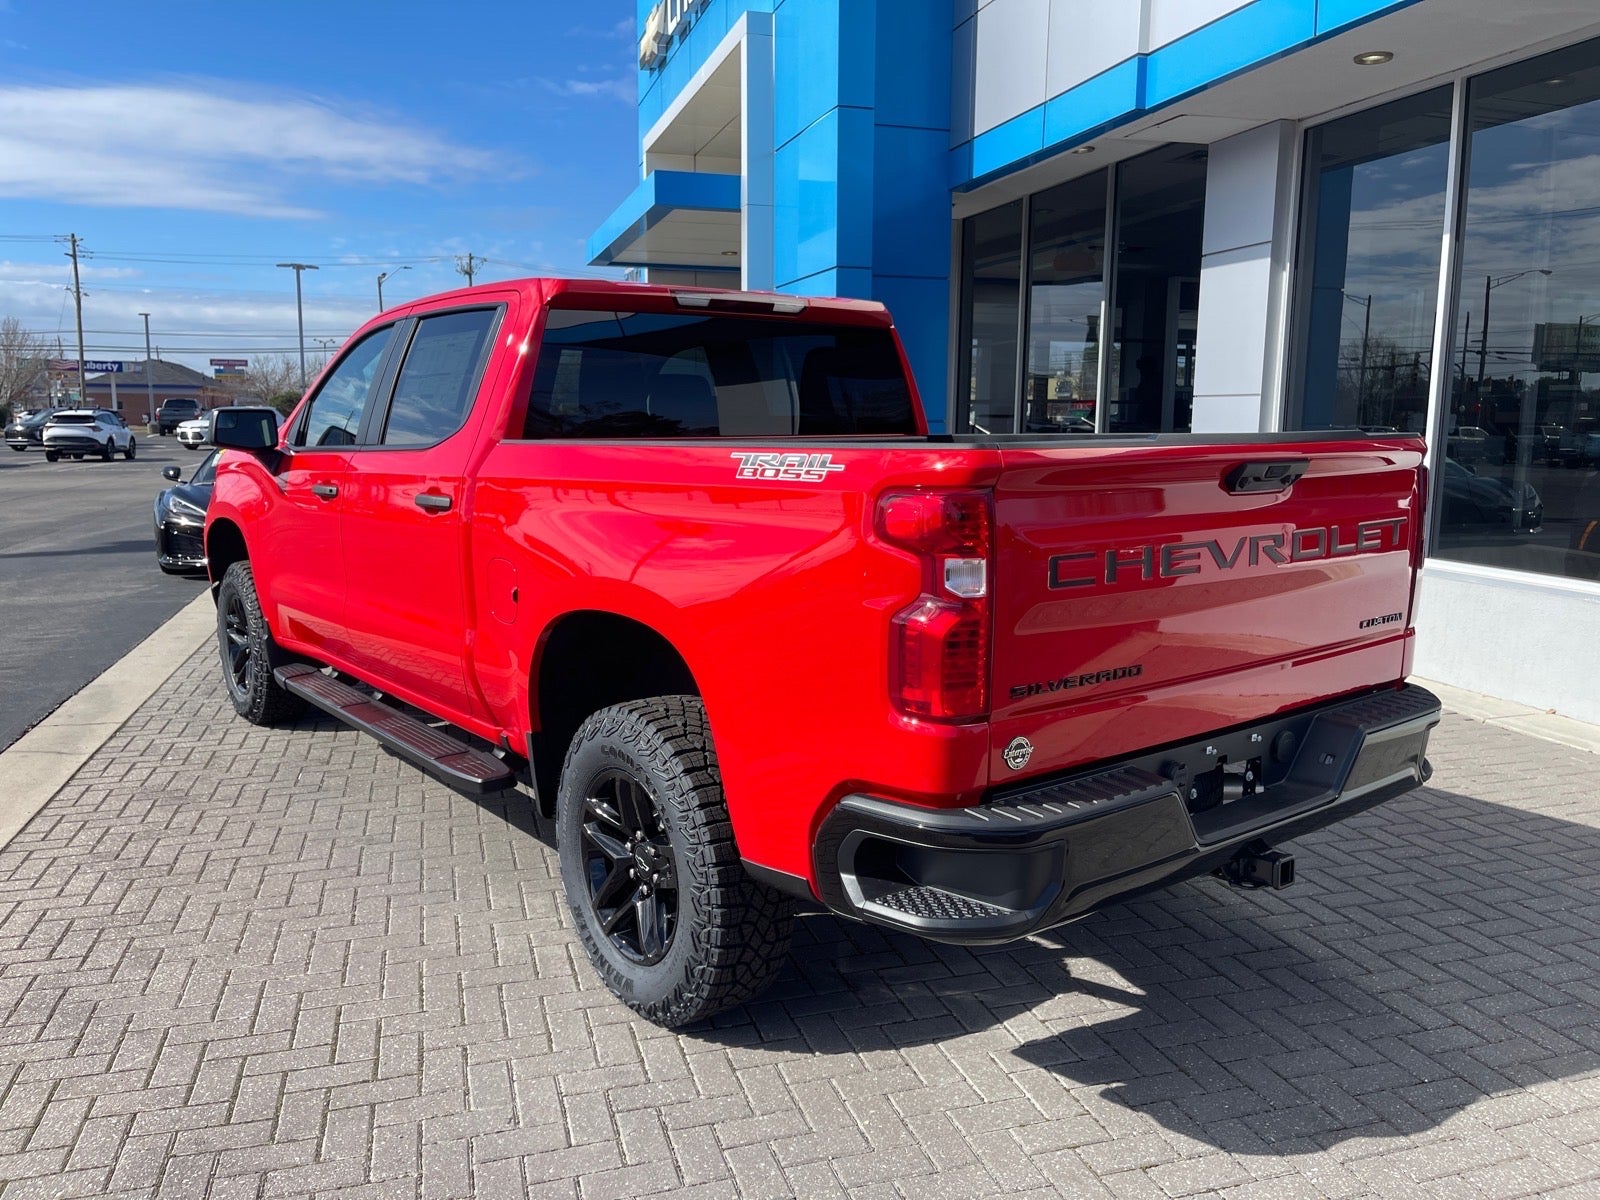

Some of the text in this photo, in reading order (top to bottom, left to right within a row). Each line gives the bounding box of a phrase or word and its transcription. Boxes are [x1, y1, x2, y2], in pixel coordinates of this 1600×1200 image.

[730, 452, 845, 471] TRAIL
[736, 466, 828, 482] BOSS
[1048, 516, 1408, 590] CHEVROLET
[1359, 612, 1403, 629] CUSTOM
[1009, 664, 1143, 699] SILVERADO
